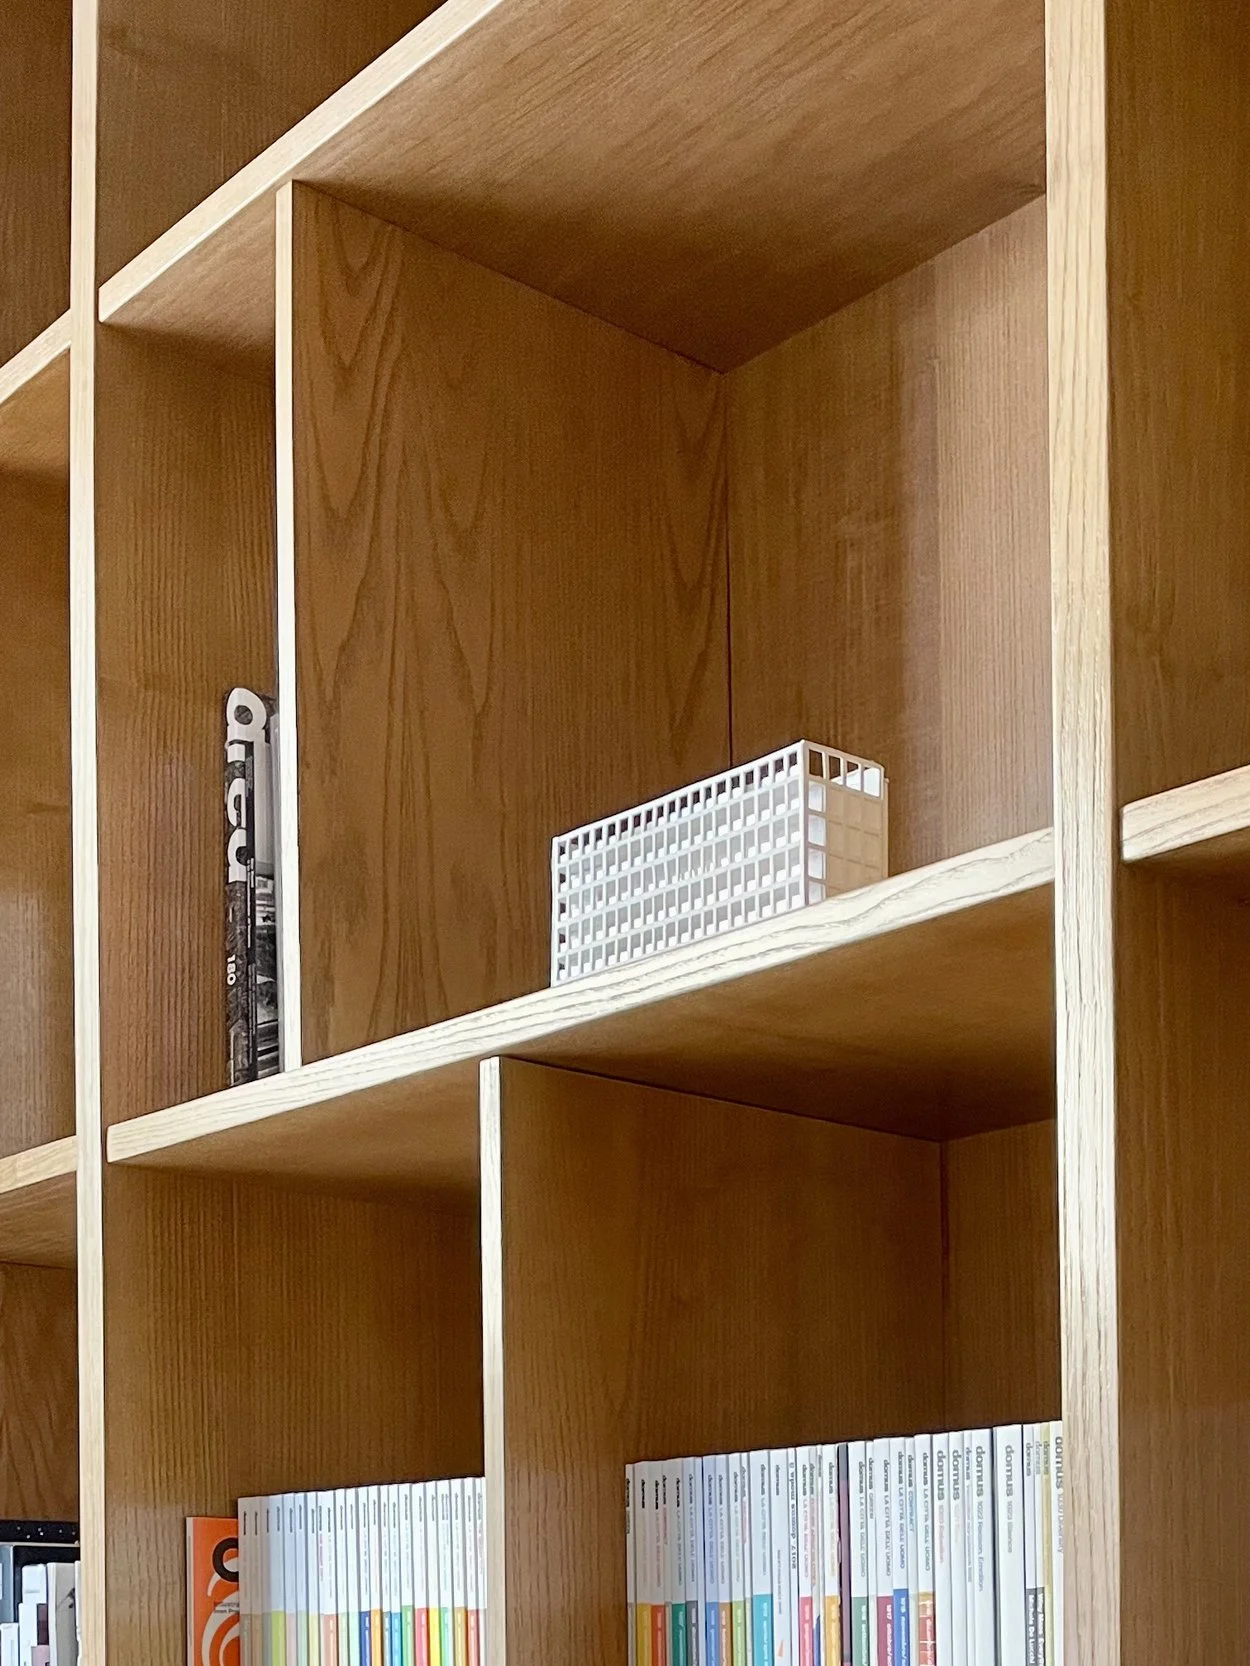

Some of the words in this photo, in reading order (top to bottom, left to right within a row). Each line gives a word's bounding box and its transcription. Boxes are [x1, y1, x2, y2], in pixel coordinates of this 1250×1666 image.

[226, 954, 237, 986] 180
[936, 1449, 946, 1501] domus
[952, 1448, 962, 1501] domus
[975, 1445, 986, 1498] domus
[1004, 1444, 1015, 1498] domus
[1028, 1627, 1035, 1637] De
[1028, 1639, 1036, 1663] Lucchi
